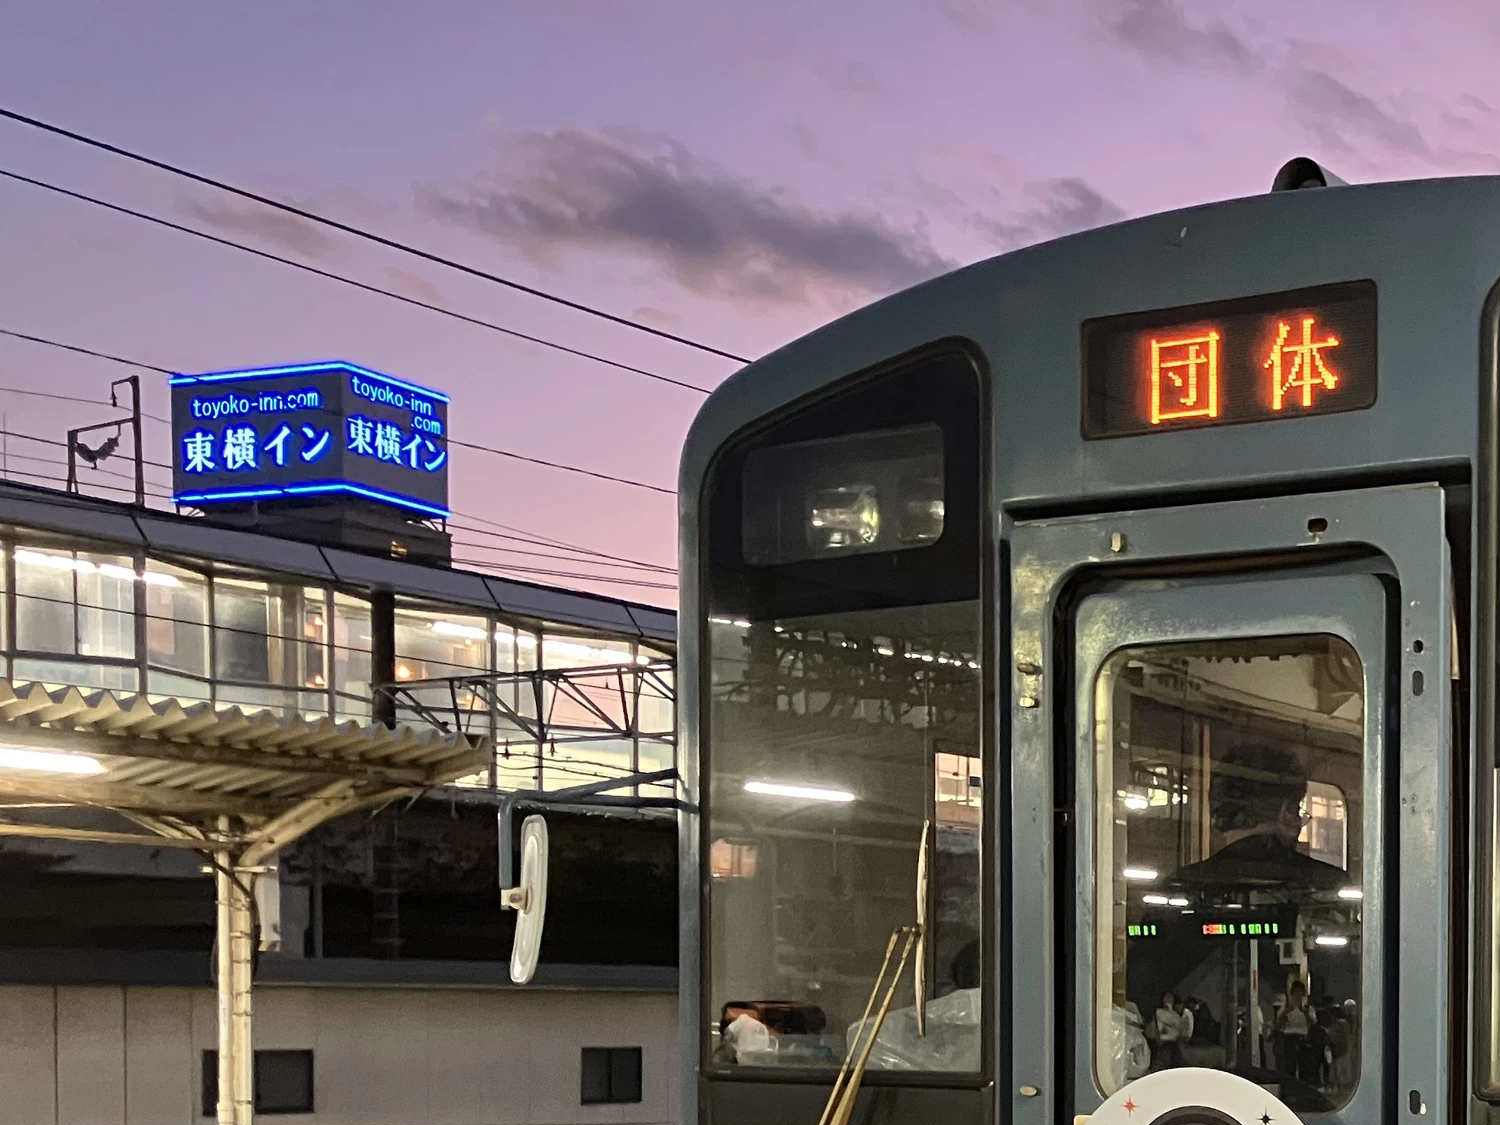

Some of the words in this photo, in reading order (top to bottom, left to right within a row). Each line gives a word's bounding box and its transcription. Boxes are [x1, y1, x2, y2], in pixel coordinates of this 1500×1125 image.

[1149, 315, 1340, 424] 団体
[193, 391, 319, 419] toyoko-inn.com
[352, 375, 432, 416] toyoko-inn
[347, 417, 447, 471] 東横イン
[411, 415, 442, 434] .com
[183, 426, 330, 472] 東横イン
